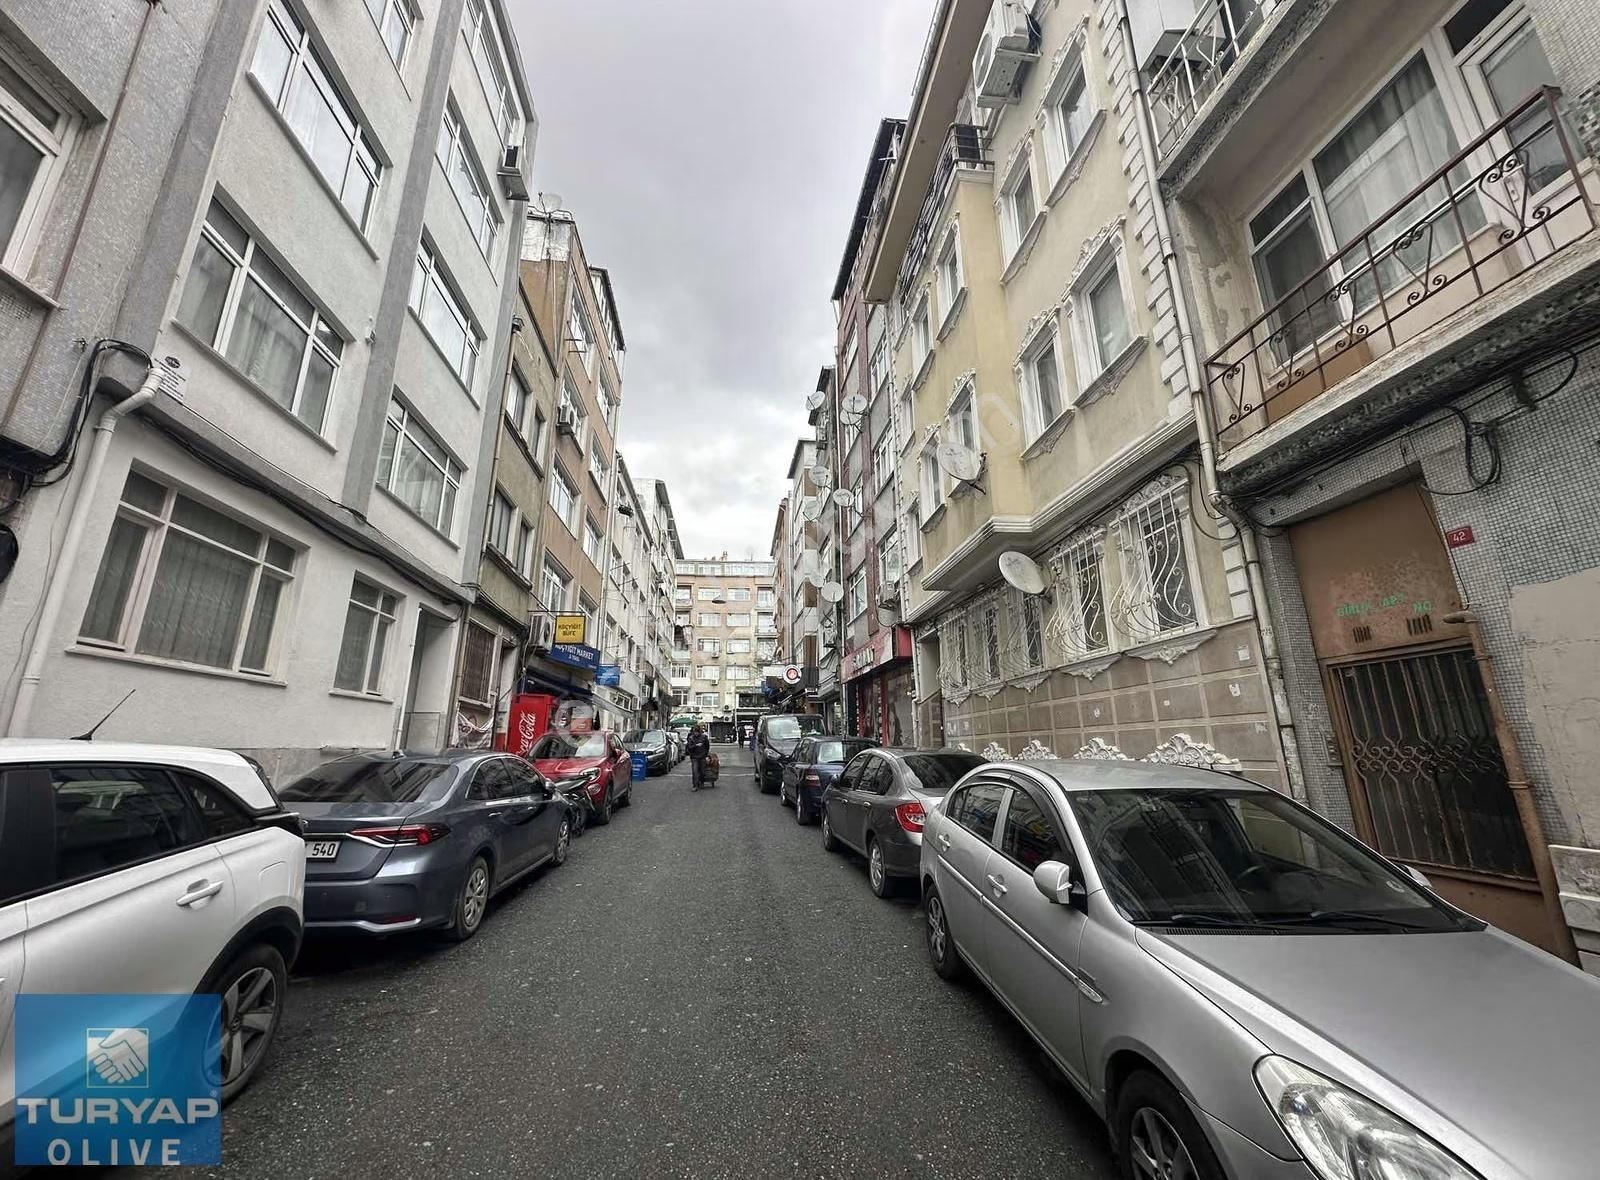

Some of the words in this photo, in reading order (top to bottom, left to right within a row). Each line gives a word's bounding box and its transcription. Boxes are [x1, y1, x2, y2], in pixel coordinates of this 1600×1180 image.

[1453, 531, 1466, 541] 42
[576, 648, 594, 660] MARKET
[312, 843, 336, 856] 540
